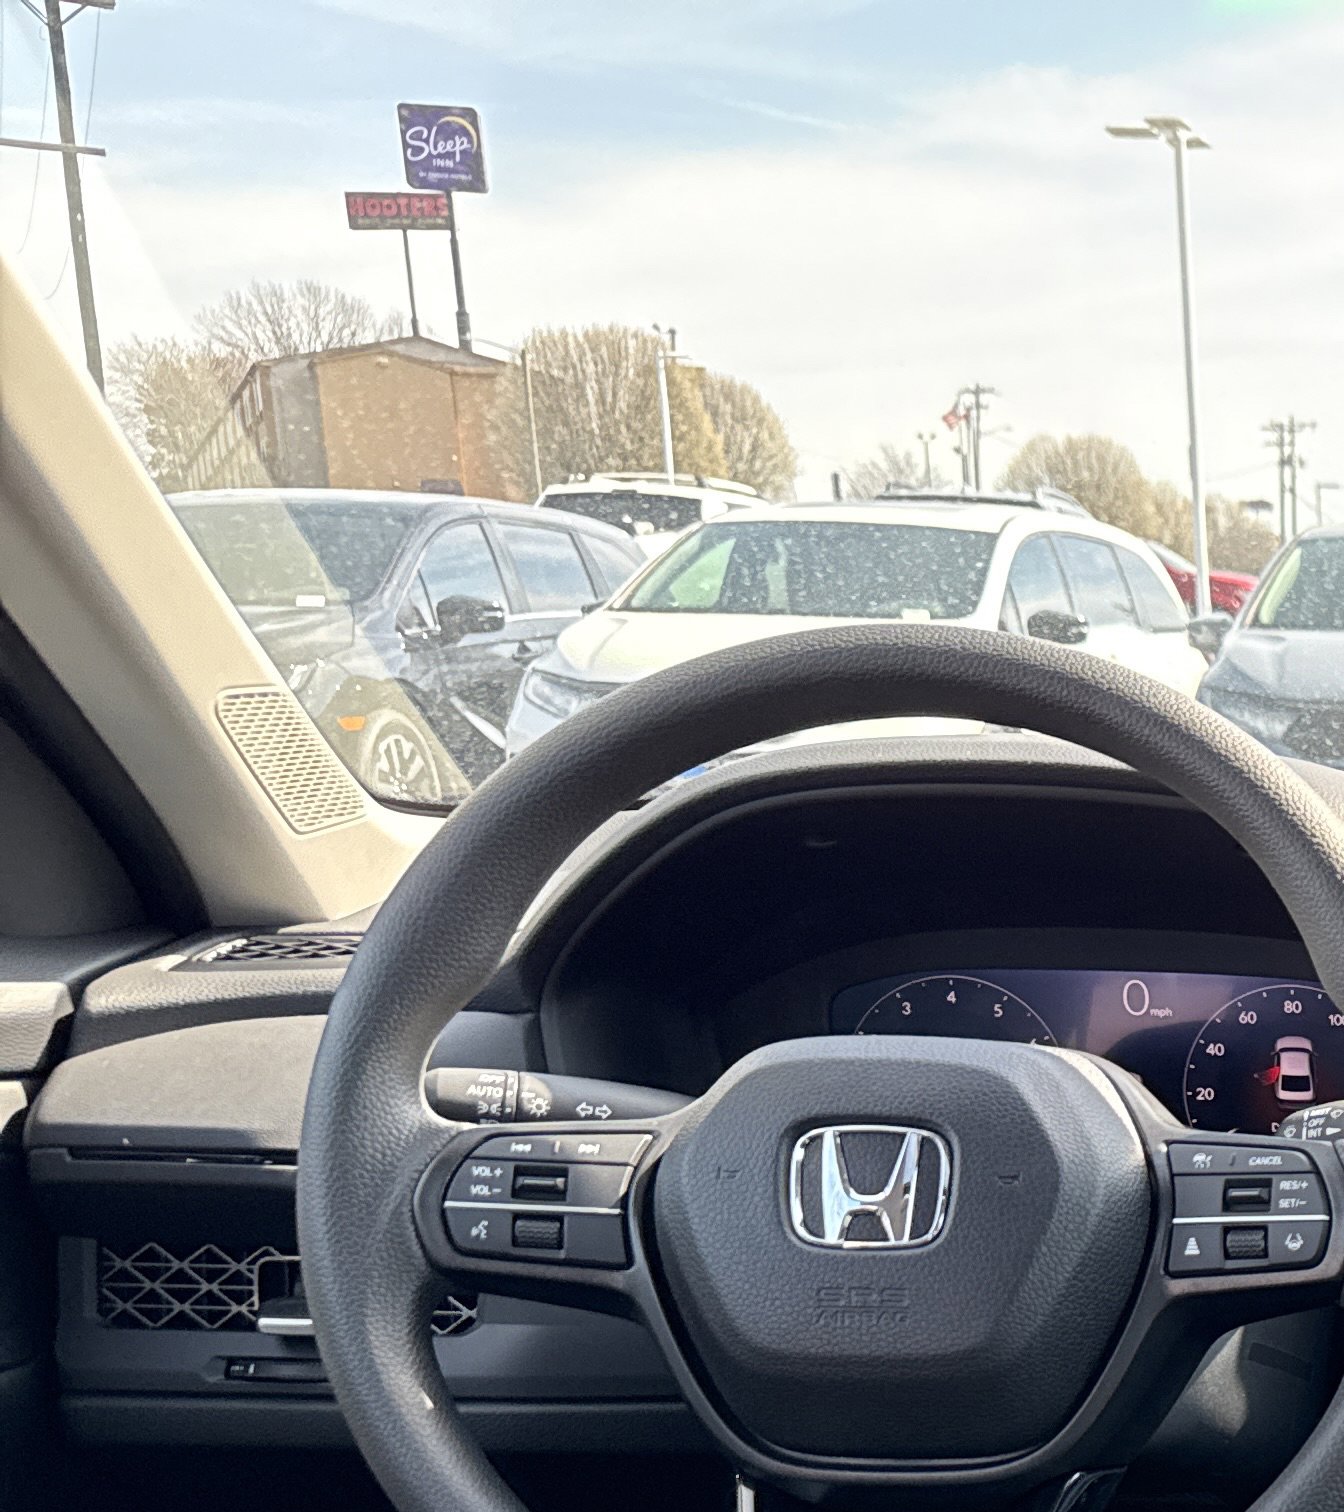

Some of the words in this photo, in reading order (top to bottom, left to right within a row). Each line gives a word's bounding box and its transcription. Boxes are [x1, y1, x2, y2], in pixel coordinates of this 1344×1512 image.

[405, 126, 471, 162] Sleep
[348, 196, 449, 217] HOOTERS
[946, 991, 957, 1004] 4
[1122, 979, 1150, 1016] 0
[1150, 1008, 1173, 1018] mph
[902, 1001, 912, 1016] 3
[993, 1003, 1003, 1018] 5
[1283, 1001, 1302, 1014] 80
[1238, 1012, 1257, 1025] 60
[1206, 1043, 1225, 1057] 40
[466, 1085, 504, 1098] AUTO
[1195, 1088, 1215, 1101] 20
[1308, 1117, 1326, 1127] OFF
[1248, 1156, 1282, 1165] CANCEL
